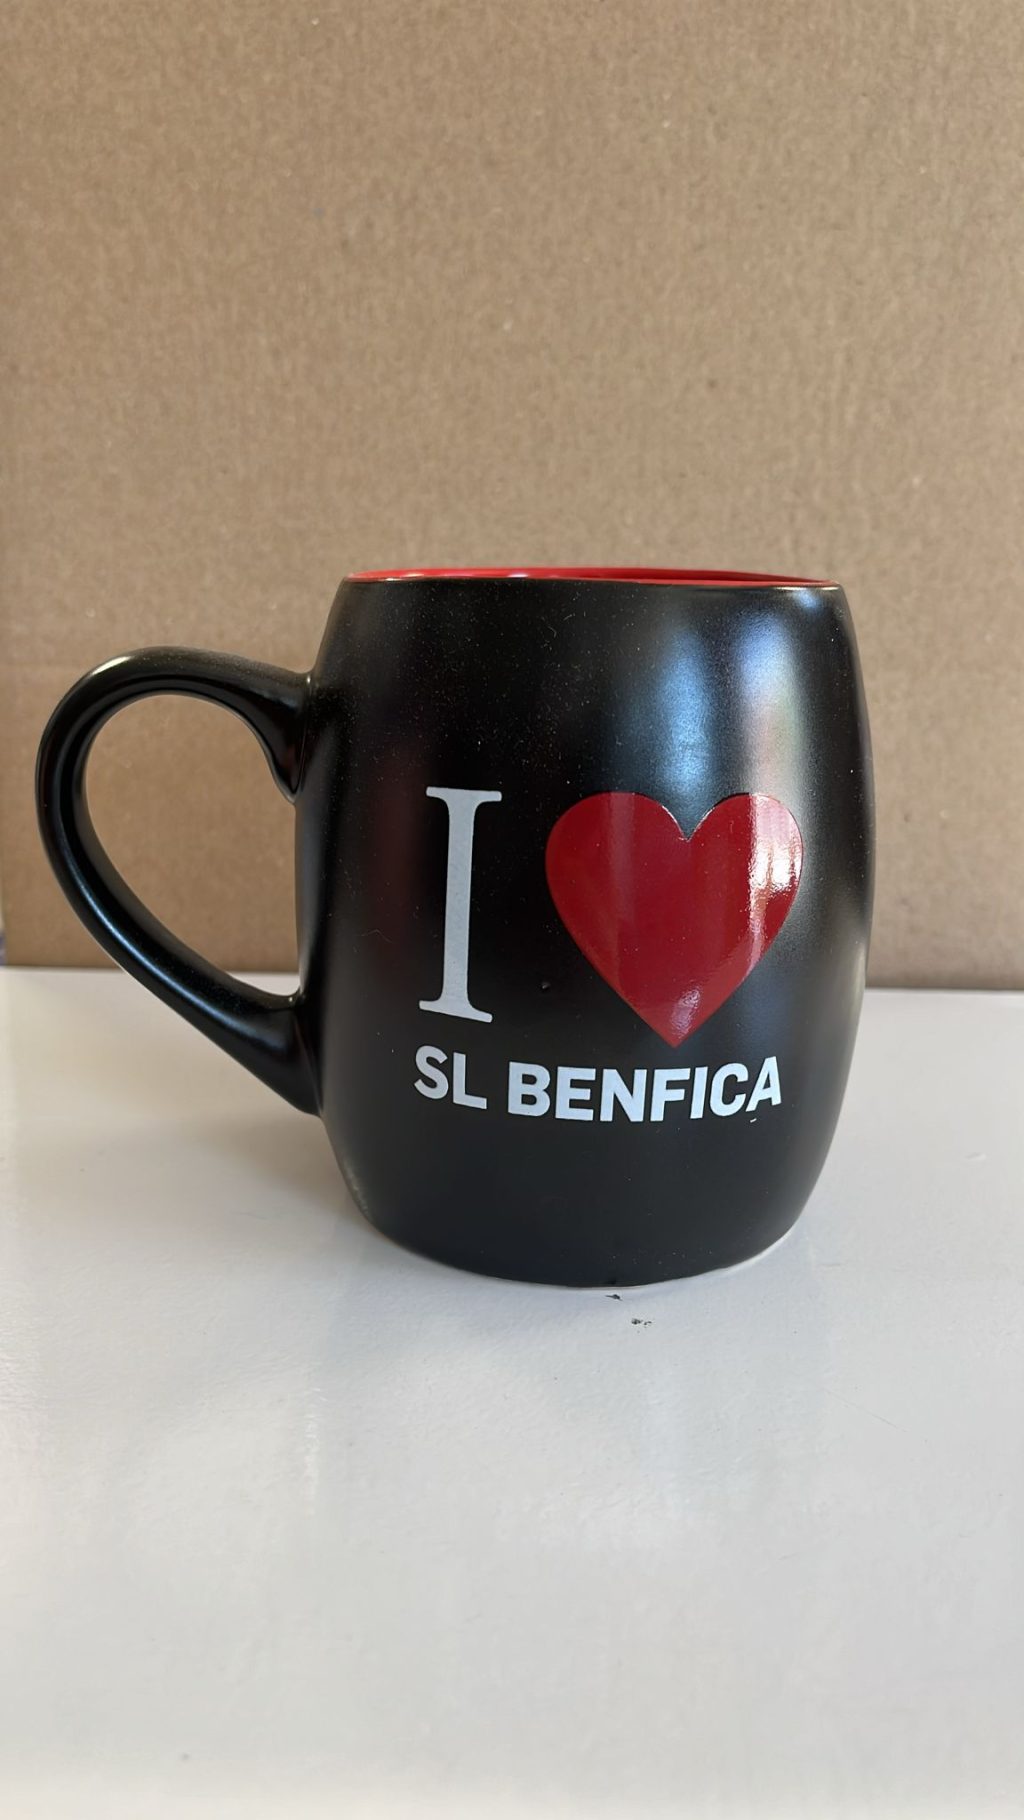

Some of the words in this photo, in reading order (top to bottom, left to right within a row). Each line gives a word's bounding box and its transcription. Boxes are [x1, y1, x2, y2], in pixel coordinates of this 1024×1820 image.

[419, 786, 502, 1023] I
[414, 1045, 487, 1110] SL
[507, 1056, 782, 1122] BENFICA
